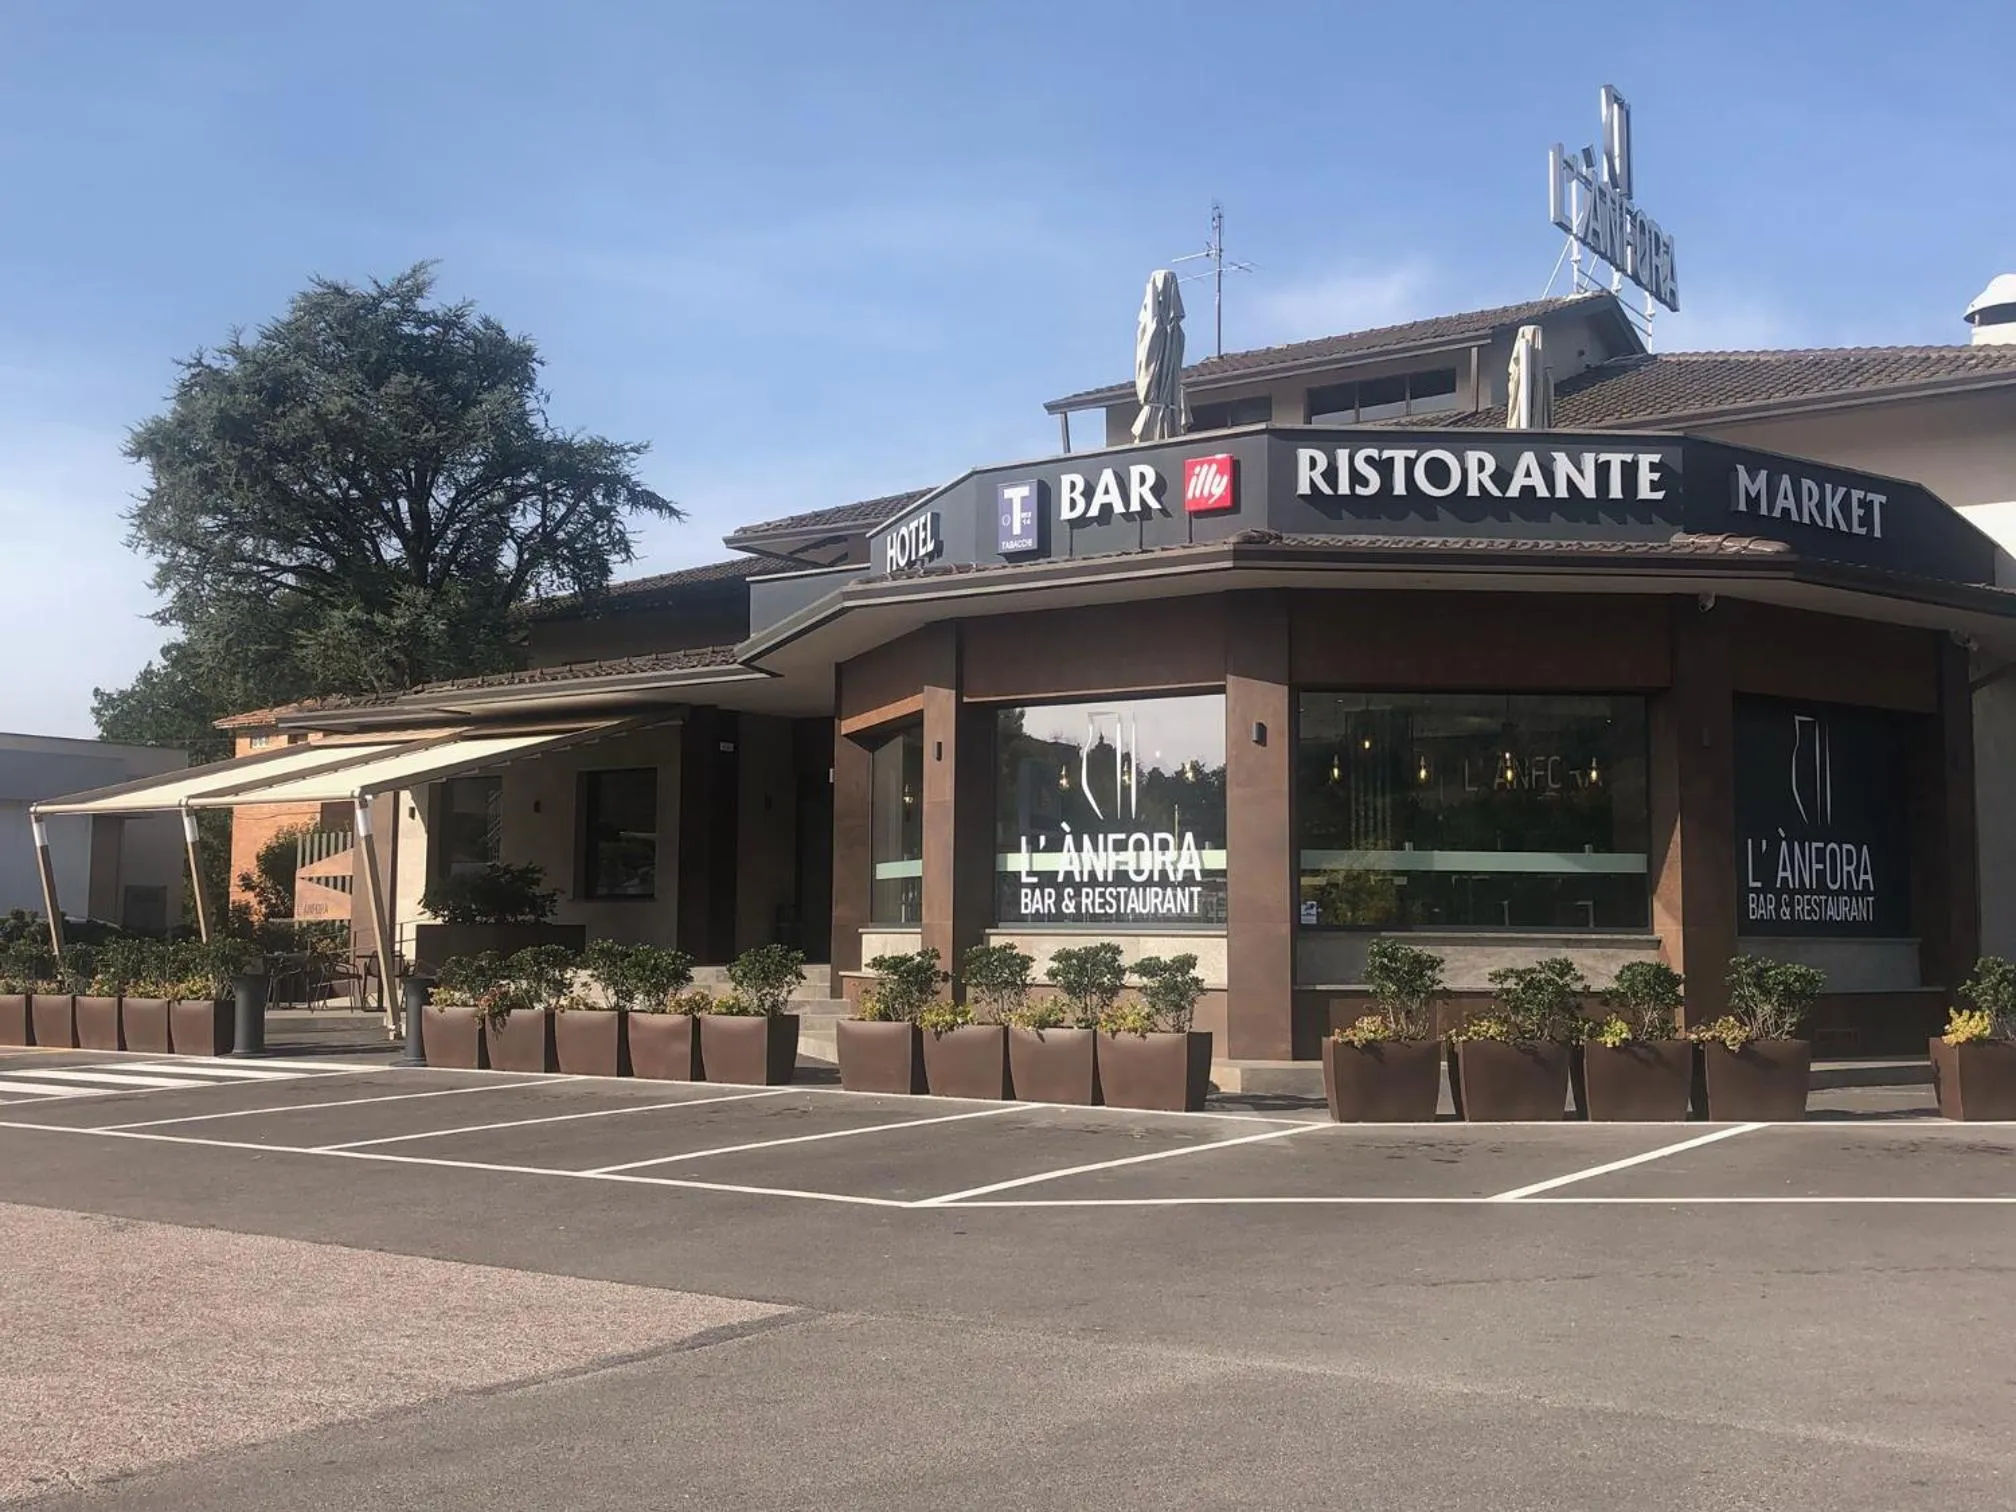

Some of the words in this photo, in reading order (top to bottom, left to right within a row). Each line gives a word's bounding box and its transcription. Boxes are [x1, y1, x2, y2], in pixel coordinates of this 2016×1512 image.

[1060, 464, 1163, 521] BAR
[1186, 466, 1229, 504] illy
[1295, 448, 1666, 500] RISTORANTE
[1003, 486, 1030, 536] T
[1734, 464, 1888, 538] MARKET
[886, 512, 936, 572] HOTEL
[1020, 887, 1056, 914] BAR
[1061, 888, 1076, 914] &
[1081, 887, 1202, 914] RESTAURANT
[1749, 893, 1776, 920] BAR
[1780, 895, 1791, 920] &
[1794, 895, 1874, 921] RESTAURANT
